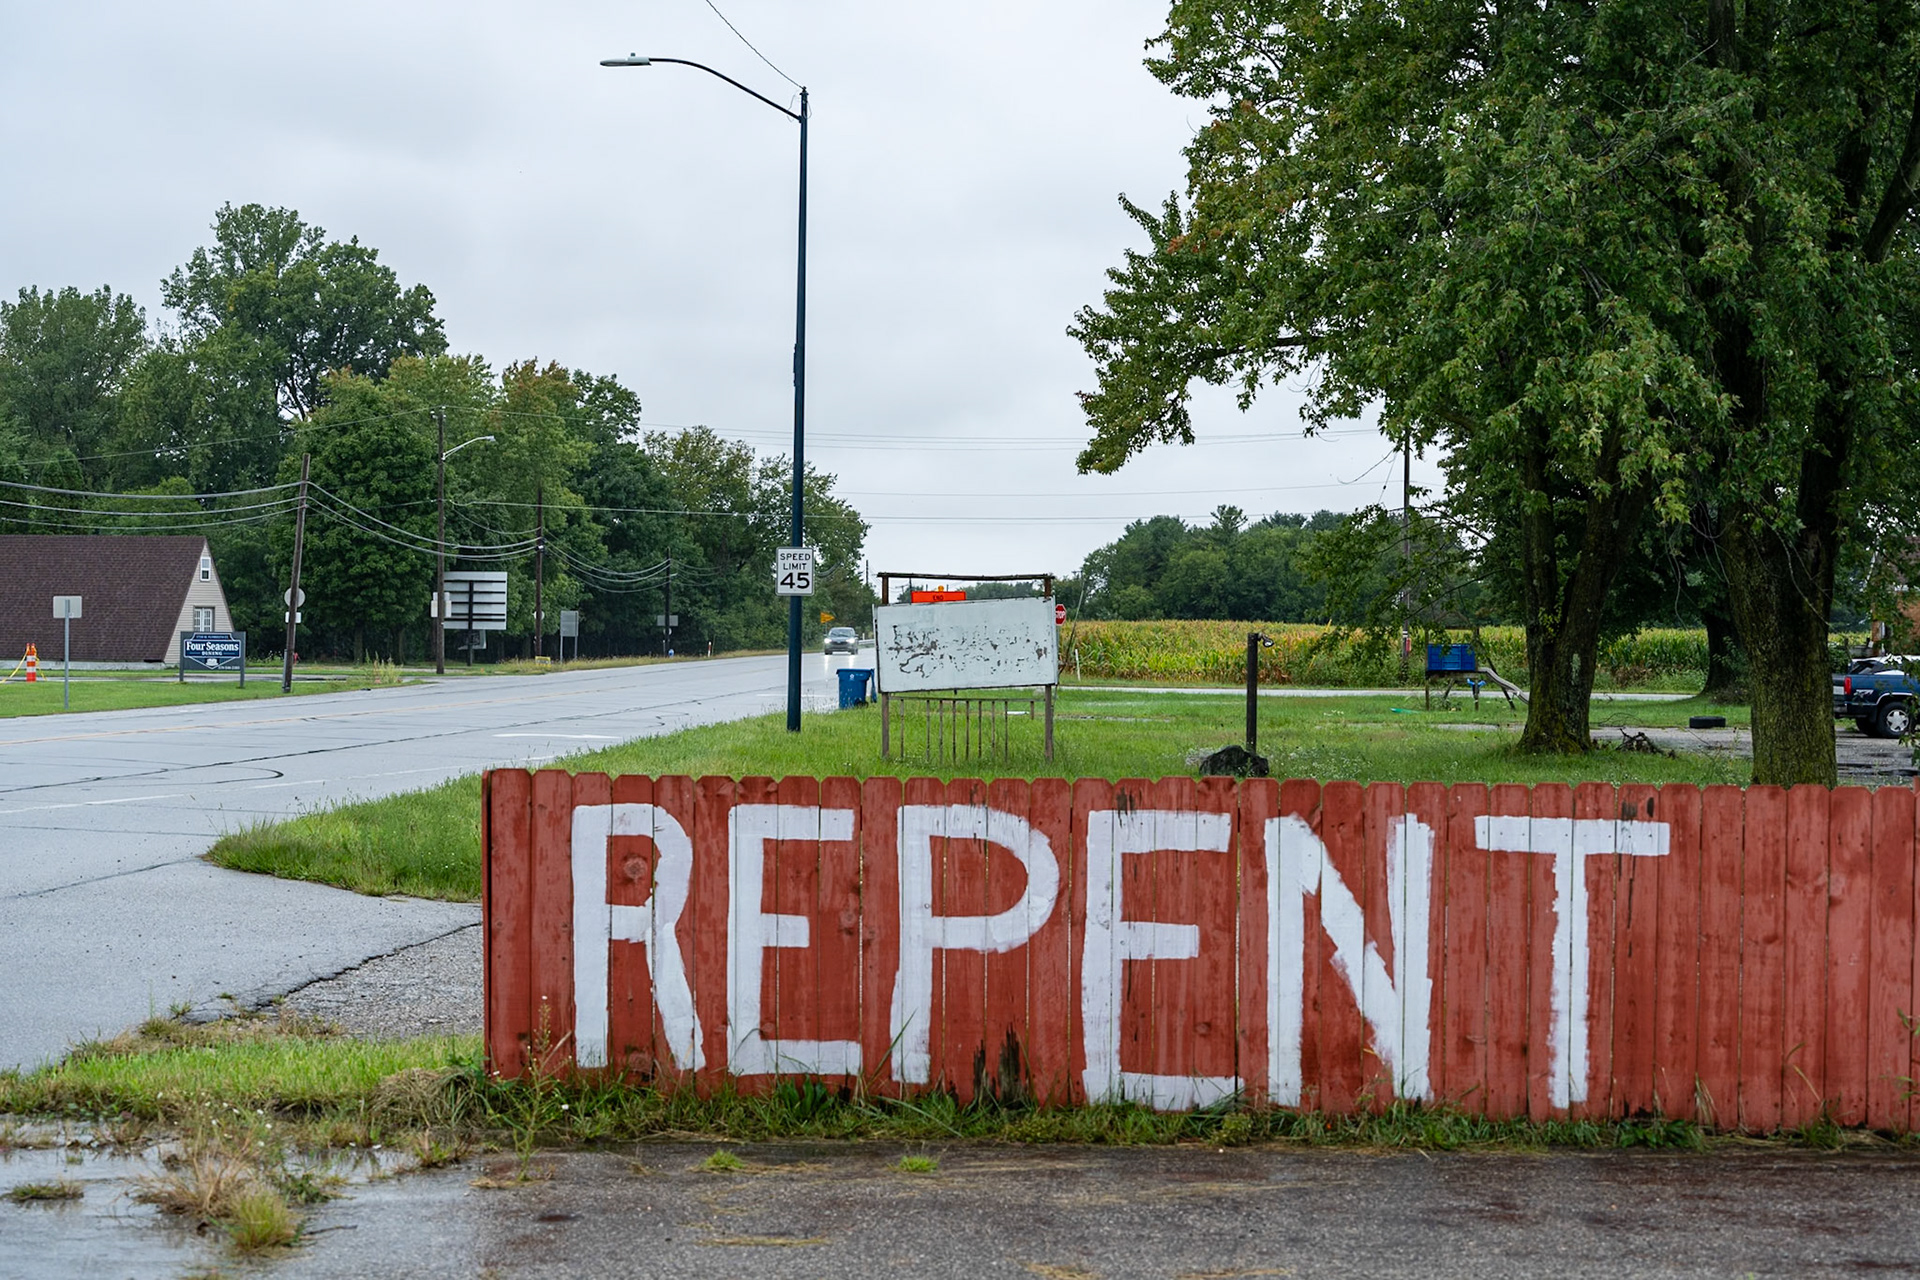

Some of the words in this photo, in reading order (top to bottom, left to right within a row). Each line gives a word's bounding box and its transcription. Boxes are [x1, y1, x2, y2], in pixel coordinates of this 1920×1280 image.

[780, 553, 811, 561] SPEED
[780, 572, 810, 589] 45
[186, 641, 205, 651] Four
[206, 641, 239, 651] Seasons
[570, 801, 1671, 1112] REPENT
